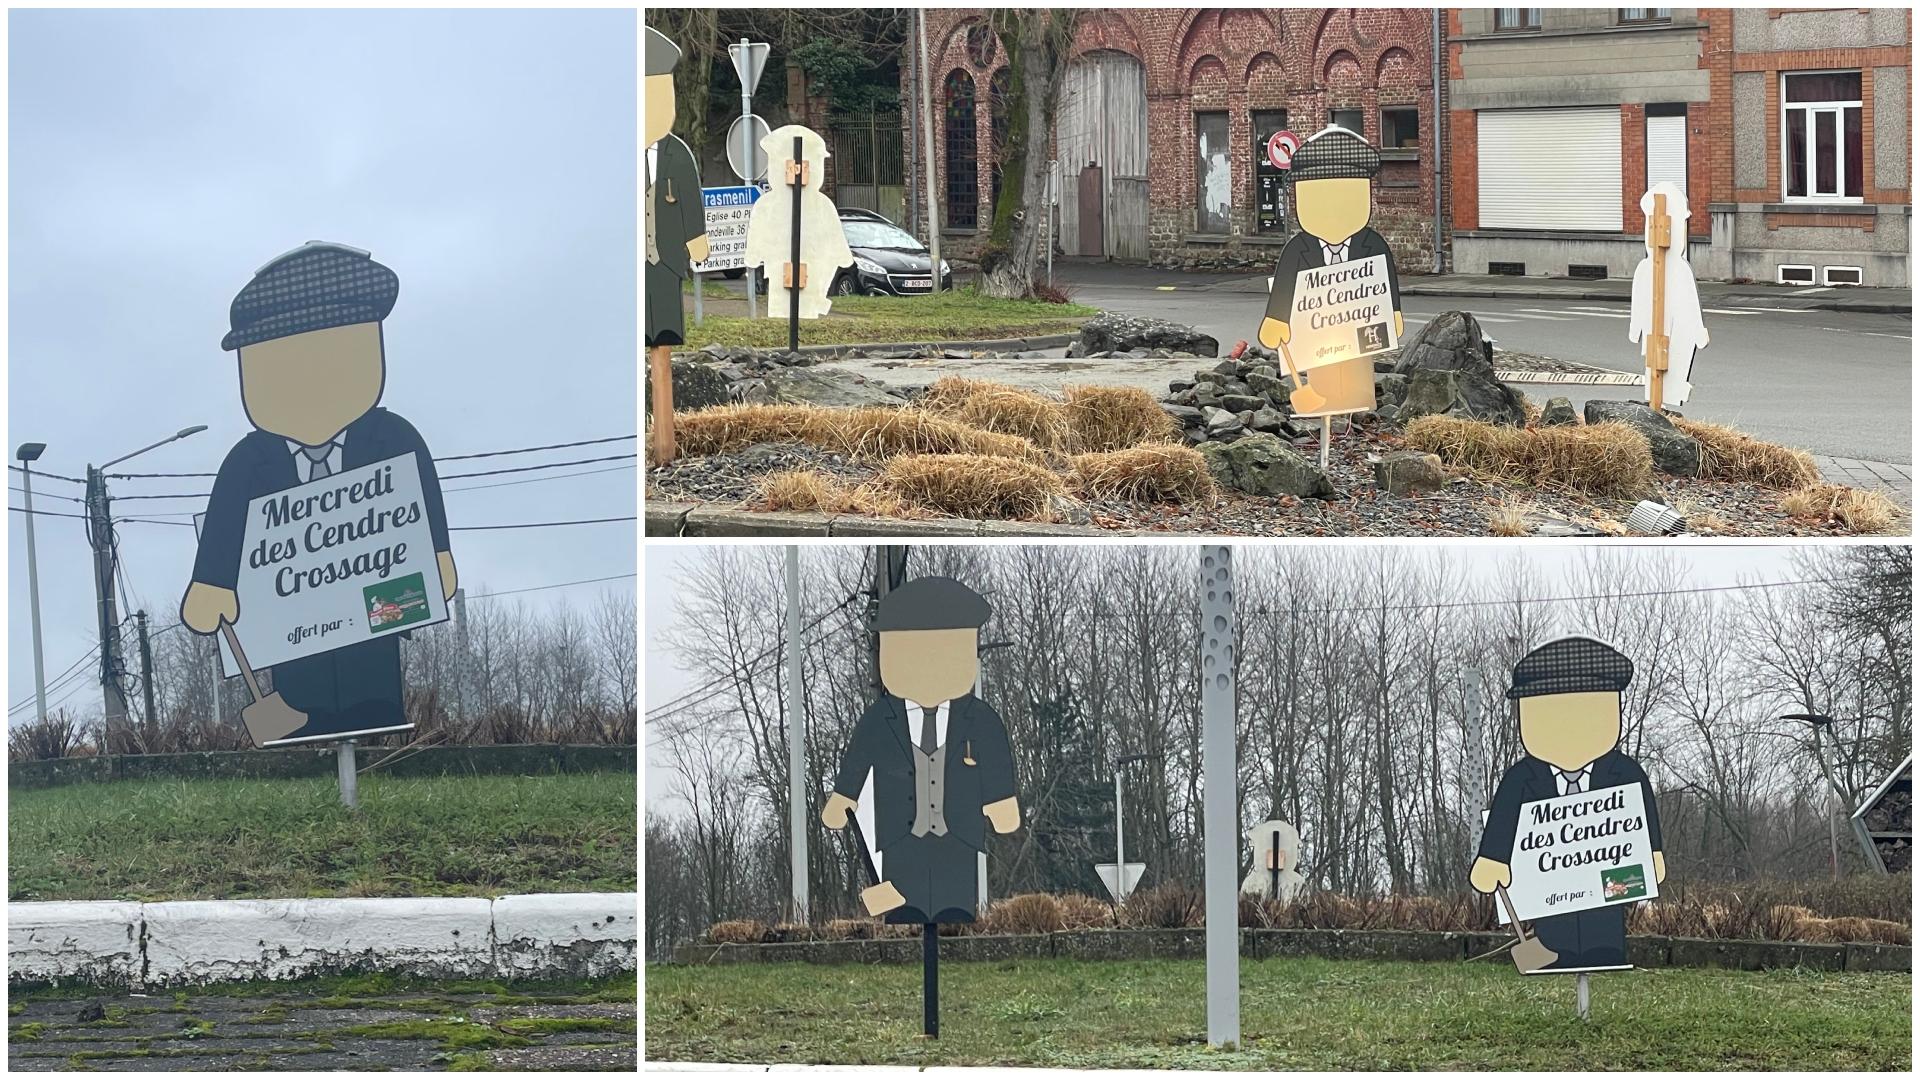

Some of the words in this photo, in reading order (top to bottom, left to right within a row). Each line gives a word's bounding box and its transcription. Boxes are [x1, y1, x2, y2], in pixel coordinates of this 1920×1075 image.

[704, 188, 752, 206] rasmenil
[731, 210, 742, 219] 40
[736, 224, 746, 235] 36
[703, 259, 731, 269] Parking
[1304, 260, 1375, 291] Mercredi
[1297, 295, 1323, 313] des
[1326, 281, 1388, 307] Cendres
[1310, 302, 1381, 330] Crossage
[1315, 345, 1334, 359] offert
[1333, 343, 1348, 355] par
[261, 465, 395, 530] Mercredi
[249, 538, 297, 569] des
[303, 500, 422, 554] Cendres
[275, 542, 408, 598] Crossage
[287, 623, 319, 645] offert
[321, 619, 344, 638] par
[1530, 789, 1626, 826] Mercredi
[1519, 831, 1555, 852] des
[1559, 815, 1644, 844] Cendres
[1538, 842, 1634, 874] Crossage
[1545, 891, 1569, 906] offert
[1569, 889, 1586, 902] par
